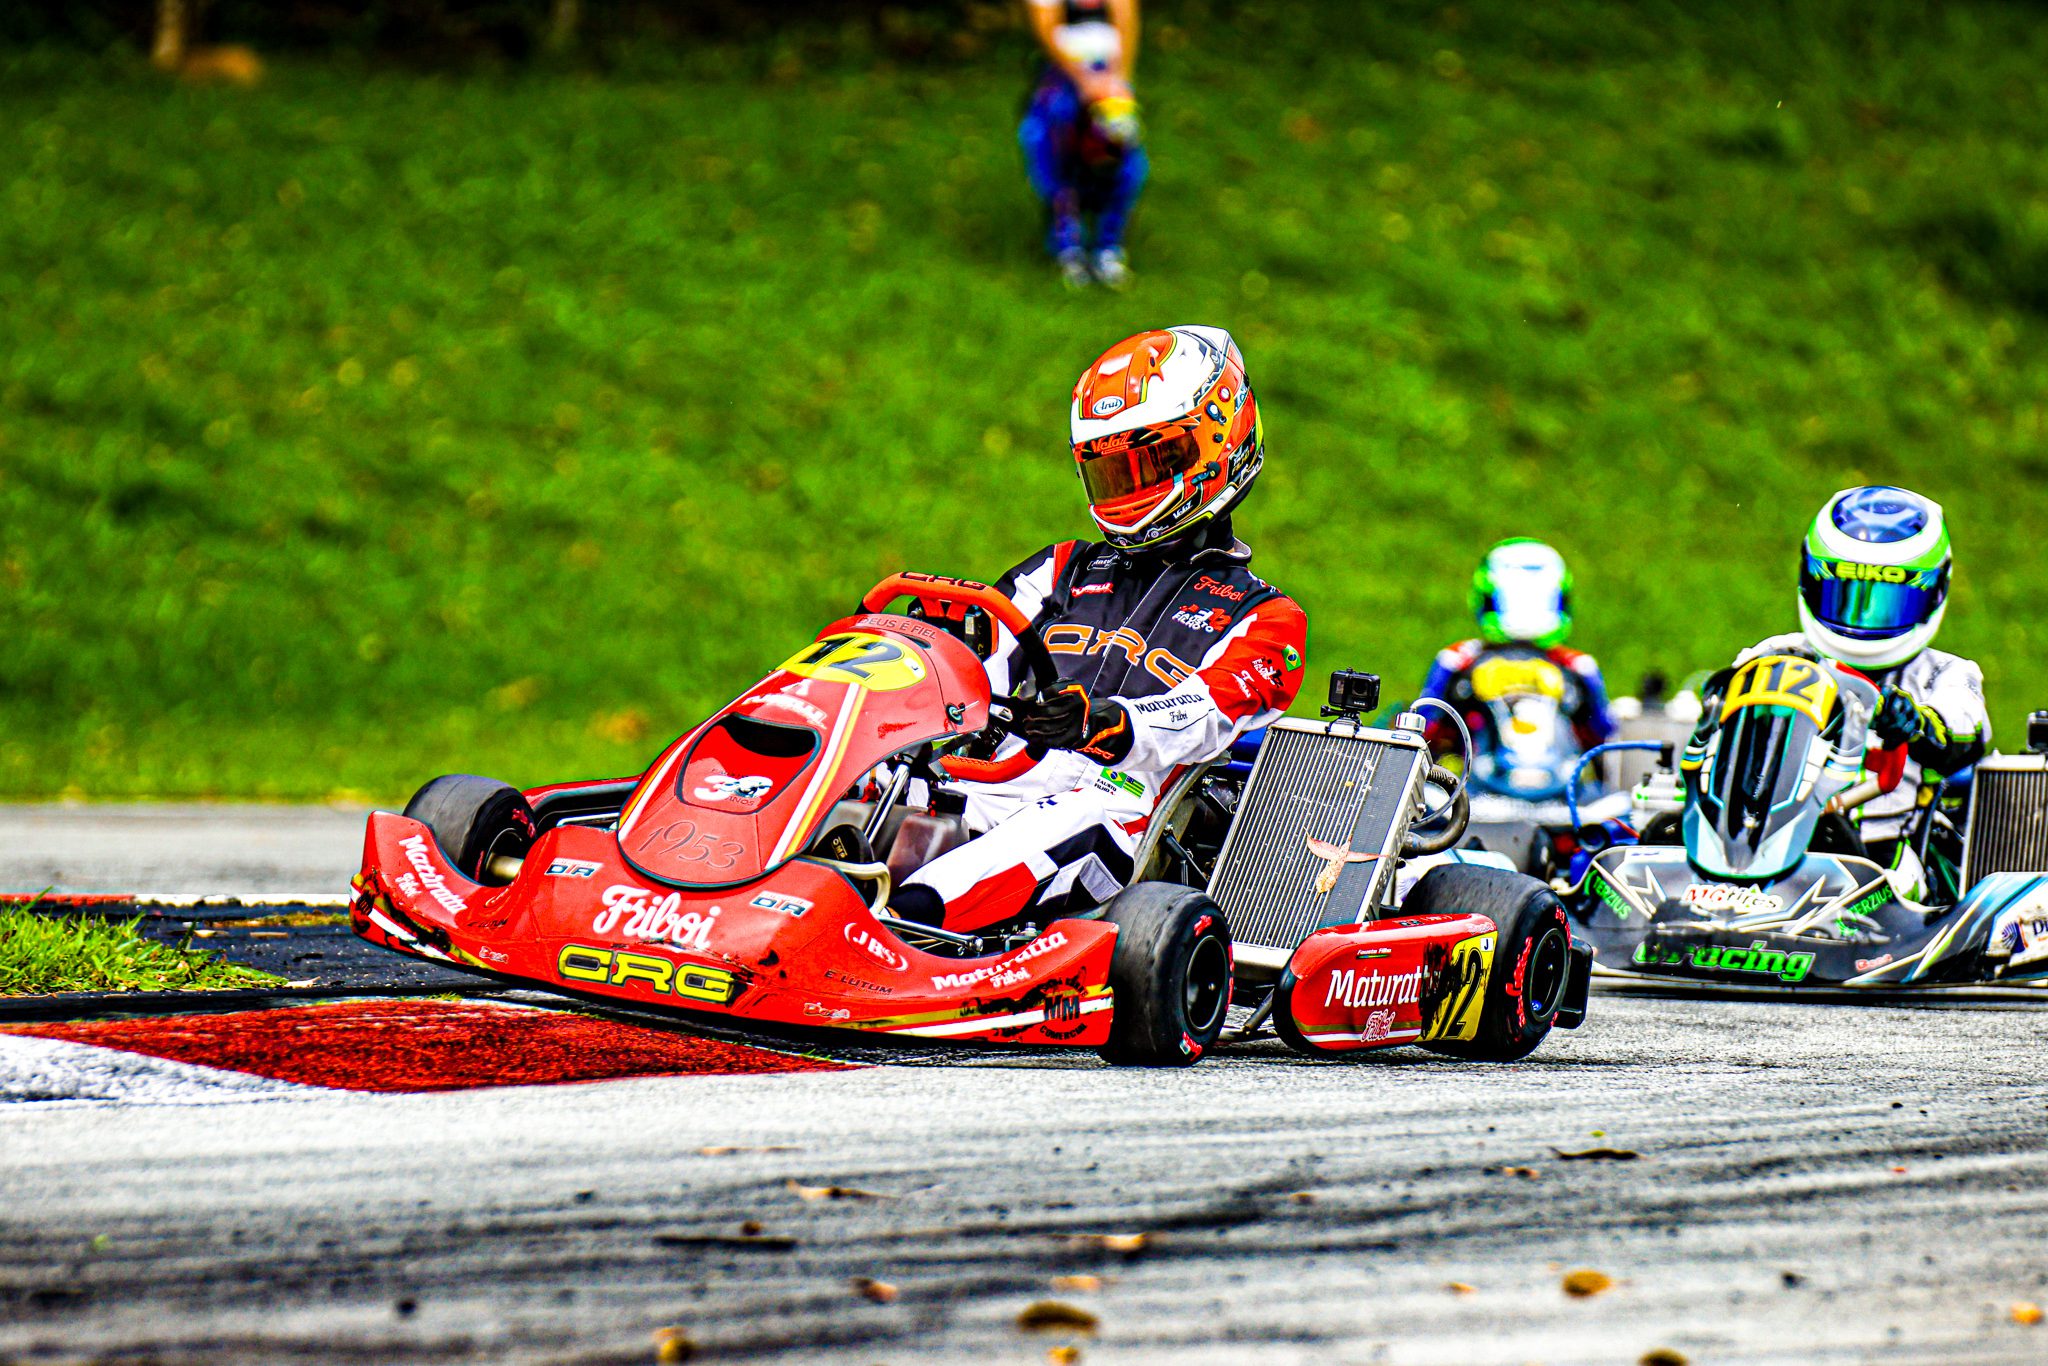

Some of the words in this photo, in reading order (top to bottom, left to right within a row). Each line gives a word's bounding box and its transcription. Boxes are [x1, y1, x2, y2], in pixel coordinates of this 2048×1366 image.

[1194, 575, 1248, 602] Friboi
[1836, 561, 1906, 583] EIKO
[857, 616, 897, 628] DEUS
[900, 620, 910, 631] É
[911, 625, 936, 640] FIEL
[797, 636, 903, 679] 12
[1043, 623, 1197, 691] CRG
[1738, 660, 1821, 703] 112
[1134, 693, 1205, 714] Maturatta
[638, 819, 745, 869] 1953
[593, 885, 722, 950] Friboi
[1592, 875, 1633, 921] TERZIUS
[853, 931, 896, 965] JBS
[931, 931, 1068, 991] Maturatta
[1484, 938, 1490, 951] J
[558, 944, 733, 1004] CRG
[990, 966, 1031, 989] Friboi
[1433, 947, 1484, 1037] 12
